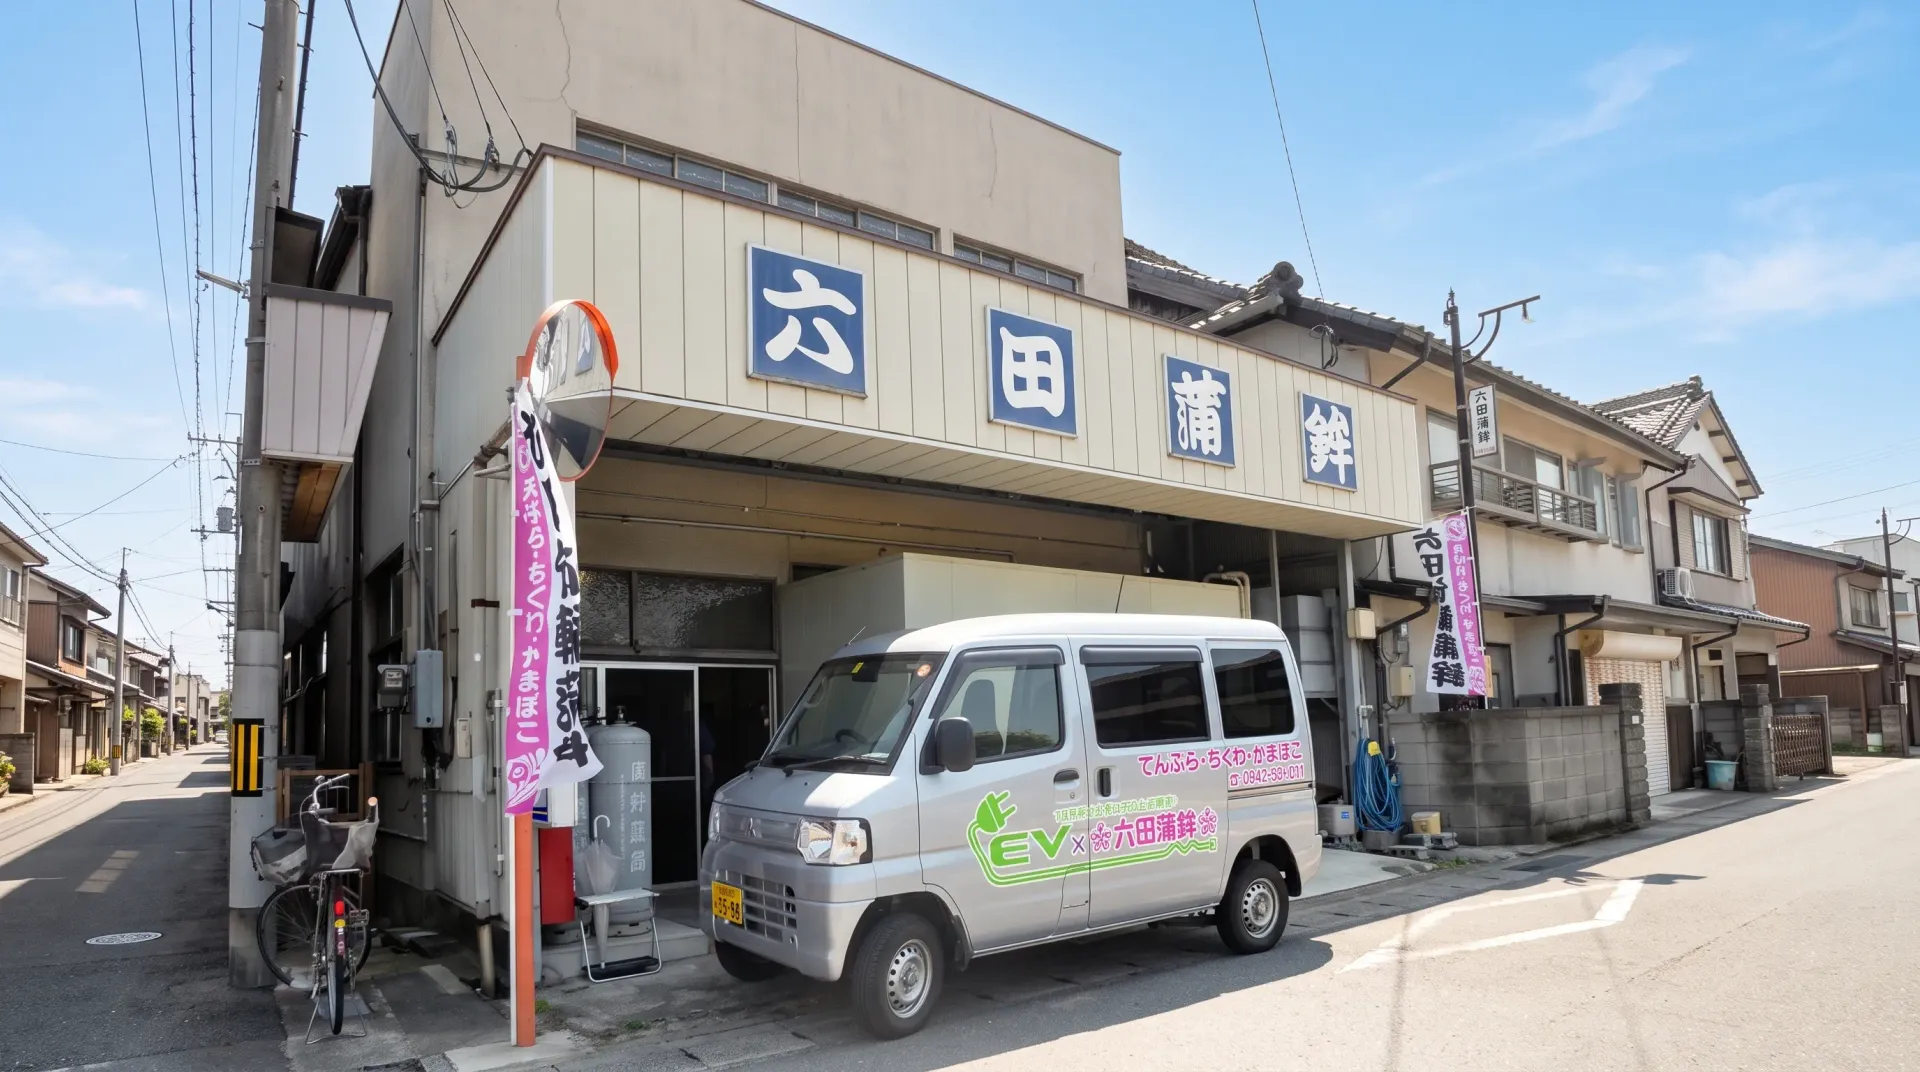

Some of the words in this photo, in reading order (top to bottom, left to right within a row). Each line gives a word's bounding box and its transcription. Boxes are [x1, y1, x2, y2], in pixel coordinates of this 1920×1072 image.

[762, 269, 1354, 485] 六田蒲鉾
[1475, 391, 1490, 443] 六田蒲鉾
[989, 825, 1071, 867] EV
[1114, 810, 1197, 849] 六田蒲鉾
